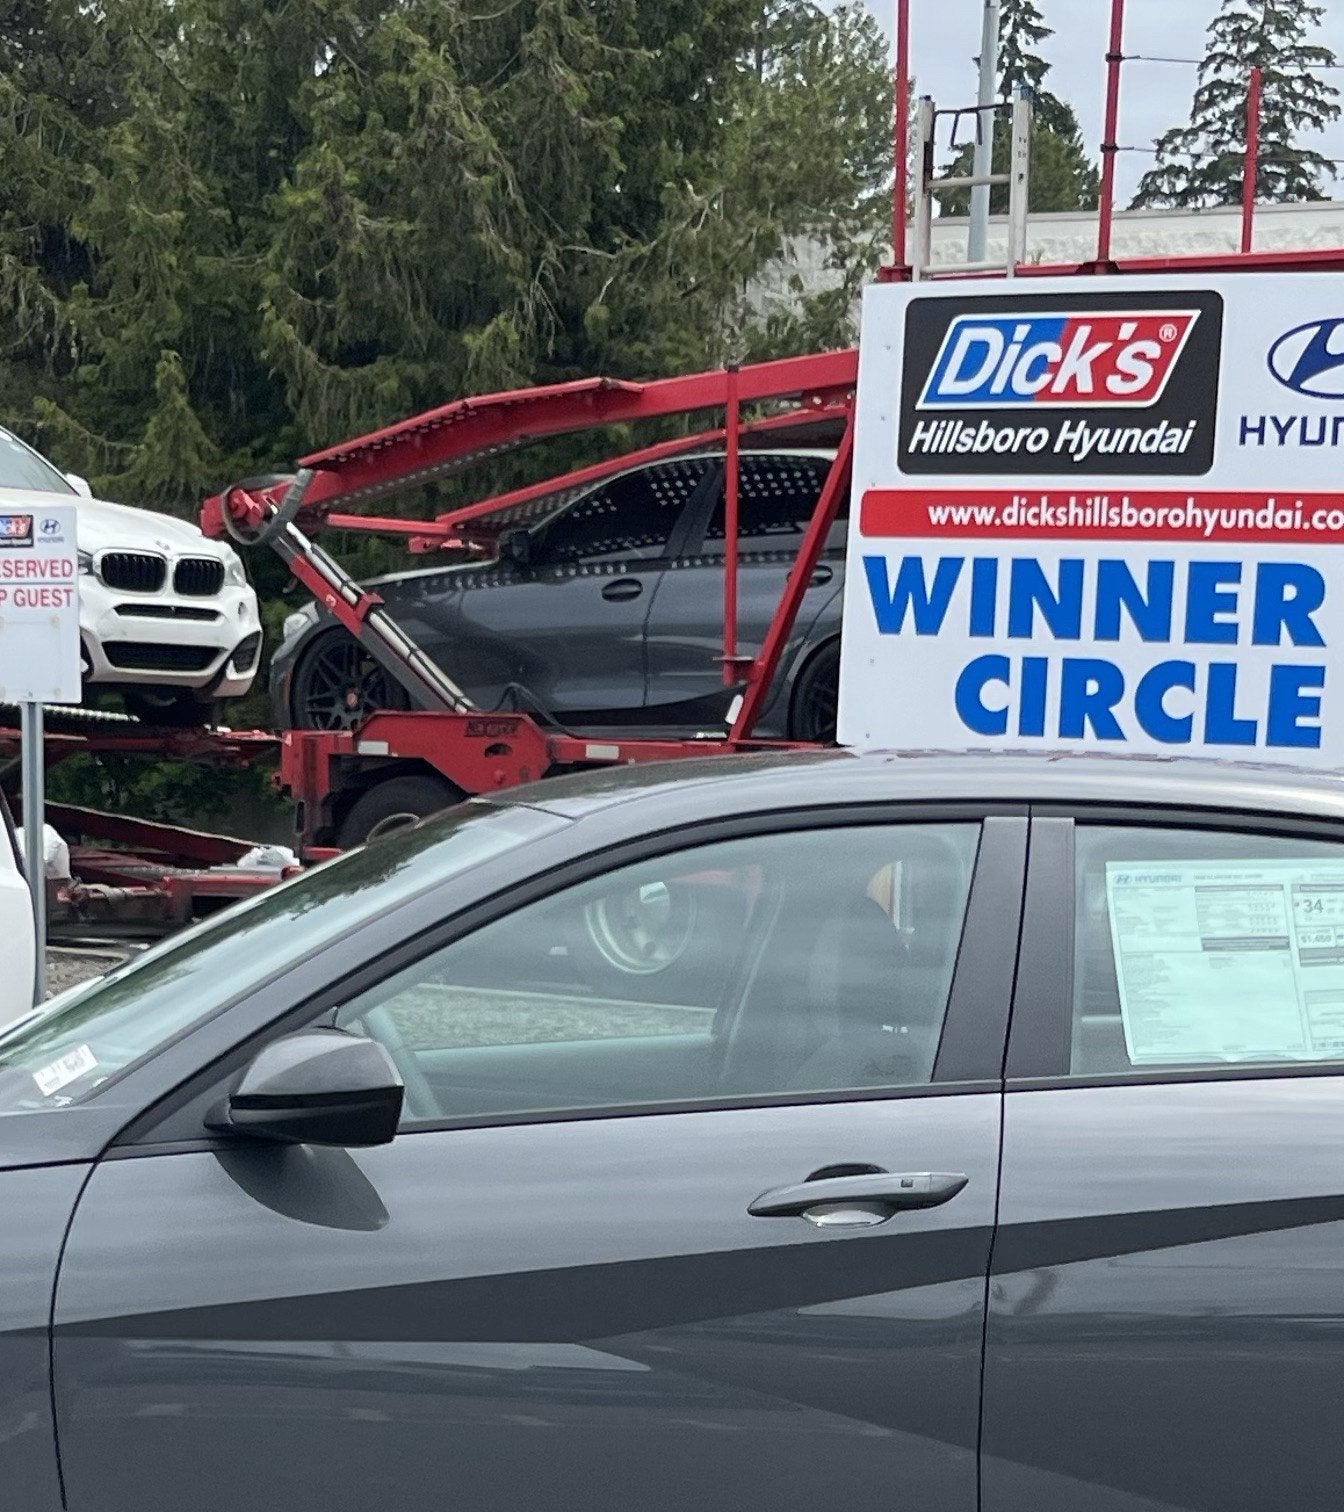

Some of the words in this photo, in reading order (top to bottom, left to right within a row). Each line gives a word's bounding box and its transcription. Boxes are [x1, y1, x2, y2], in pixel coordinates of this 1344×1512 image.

[937, 322, 1162, 395] Dick's
[908, 420, 1049, 455] Hillsboro
[1053, 418, 1197, 462] Hyundai
[13, 588, 73, 608] GUEST
[955, 654, 1326, 749] CIRCLE
